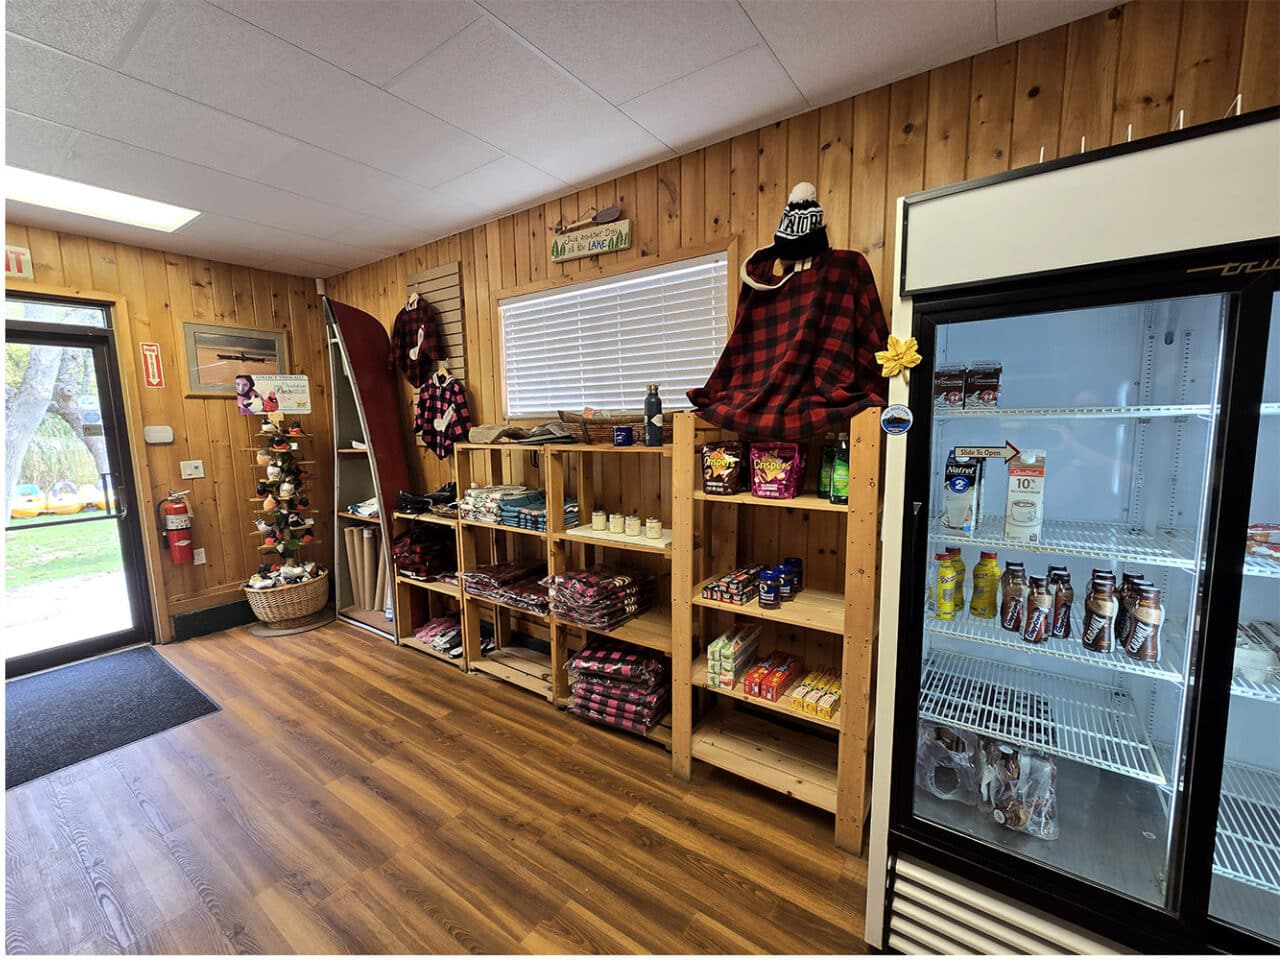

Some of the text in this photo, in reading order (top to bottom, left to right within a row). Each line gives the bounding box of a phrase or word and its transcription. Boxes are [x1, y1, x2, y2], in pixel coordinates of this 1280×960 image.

[587, 239, 608, 252] LAKE
[960, 448, 975, 456] Slide
[984, 449, 1001, 457] Open
[704, 457, 735, 468] Crispers
[754, 459, 793, 470] Crispers
[946, 465, 976, 475] Natrel
